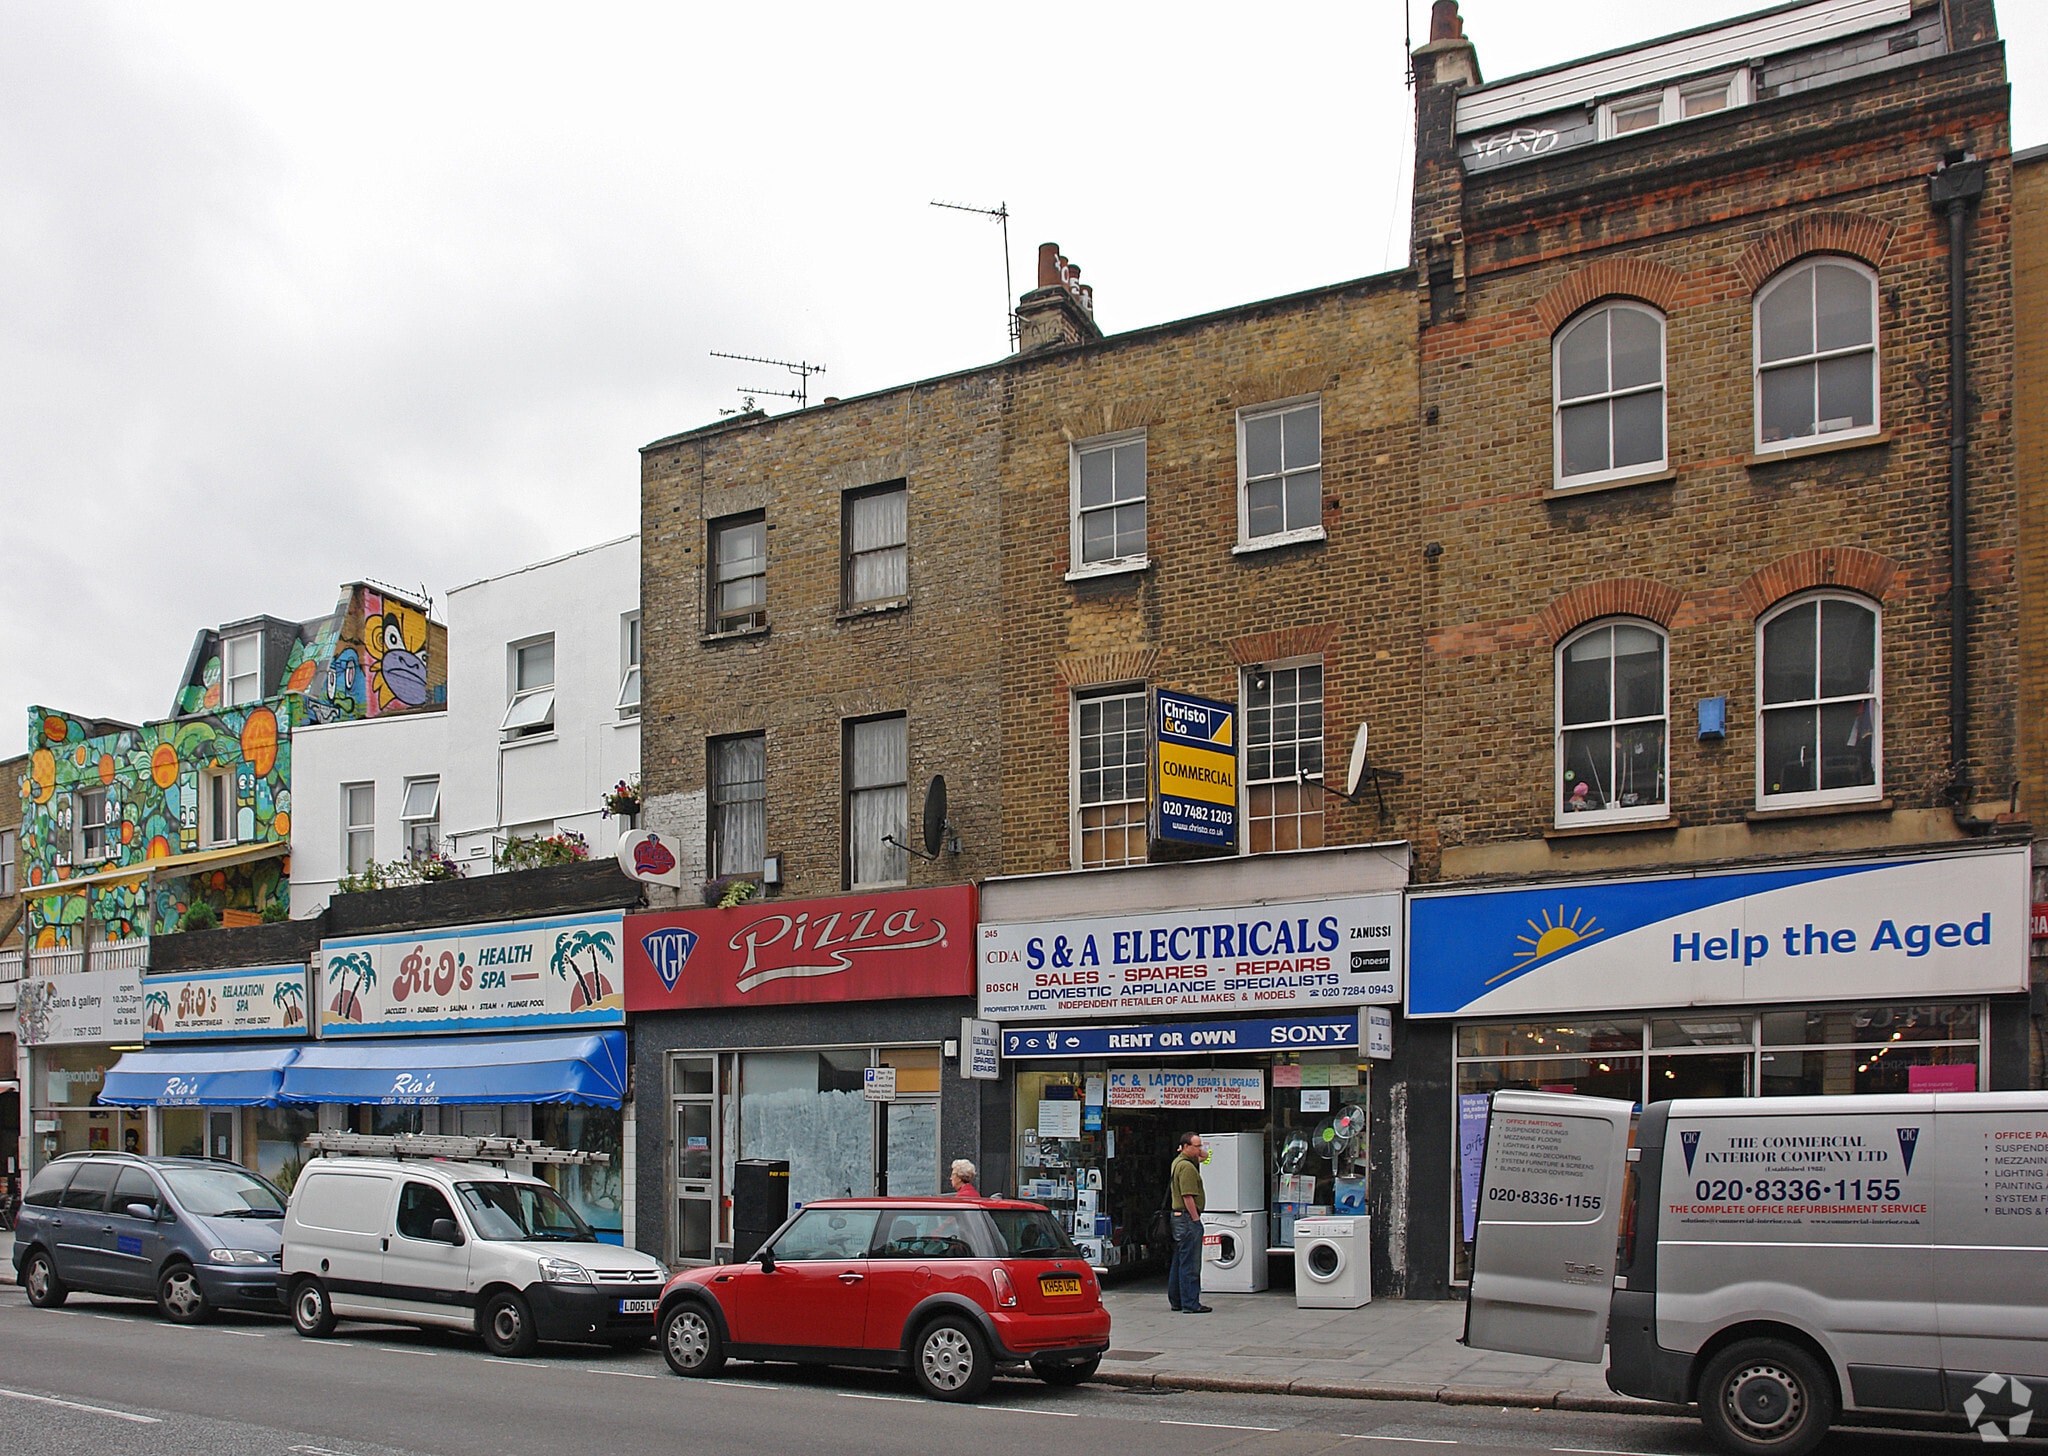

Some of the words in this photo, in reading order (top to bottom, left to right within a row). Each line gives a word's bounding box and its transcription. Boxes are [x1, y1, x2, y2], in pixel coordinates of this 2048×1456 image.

[1164, 702, 1206, 724] Christo
[1163, 760, 1233, 787] COMMERCIAL
[1163, 801, 1182, 816] 020
[1184, 804, 1208, 821] 7482
[1210, 809, 1232, 825] 1203
[1172, 821, 1224, 836] www.christo.co.uk
[984, 930, 998, 938] 245
[1350, 925, 1392, 939] ZANUSSI
[729, 908, 935, 982] Pizza
[1026, 937, 1045, 970] S
[1052, 935, 1073, 968] &
[1079, 934, 1100, 966] A
[1113, 916, 1339, 965] ELECTRICALS
[1673, 928, 1769, 967] Help
[1782, 923, 1857, 956] the
[1870, 912, 1991, 957] Aged
[478, 944, 533, 966] HEALTH
[650, 933, 690, 981] TGF
[1035, 971, 1100, 987] SALES
[1124, 965, 1208, 982] SPARES
[1236, 957, 1331, 976] REPAIRS
[479, 970, 506, 990] SPA
[1028, 986, 1112, 1000] DOMESTIC
[1120, 980, 1216, 995] APPLIANCE
[1224, 974, 1339, 990] SPECIALISTS
[119, 985, 134, 993] open
[222, 983, 264, 998] RELAXATION
[986, 983, 1019, 993] BOSCH
[1322, 988, 1339, 997] 020
[1342, 986, 1366, 996] 7284
[1368, 984, 1394, 995] 0943
[52, 997, 70, 1009] salon
[72, 996, 77, 1007] &
[79, 995, 101, 1009] gallery
[236, 999, 249, 1012] SPA
[529, 999, 544, 1007] POOL
[1058, 998, 1118, 1009] INDEPENDENT
[1121, 996, 1163, 1006] RETAILER
[1166, 995, 1178, 1005] OF
[1181, 994, 1198, 1004] ALL
[1201, 992, 1235, 1002] MAKES
[1242, 993, 1248, 1001] &
[1255, 990, 1296, 1001] MODELS
[984, 1004, 1019, 1013] PROPRIETOR
[191, 1018, 223, 1027] SPORTSWEAR
[1109, 1033, 1153, 1048] RENT
[1160, 1032, 1184, 1046] OR
[1190, 1030, 1237, 1044] OWN
[1271, 1024, 1351, 1043] SONY
[975, 1048, 994, 1056] SALES
[974, 1056, 996, 1065] SPARES
[973, 1064, 997, 1073] REPAIRS
[163, 1077, 198, 1096] Rio's
[390, 1073, 436, 1094] Rio's
[1112, 1073, 1126, 1086] PC
[1132, 1073, 1141, 1086] &
[1150, 1073, 1194, 1086] LAPTOP
[1198, 1078, 1220, 1087] REPAIRS
[1230, 1078, 1260, 1087] UPGRADES
[1683, 1133, 1698, 1144] CIC
[1728, 1137, 1758, 1149] THE
[1763, 1136, 1866, 1148] COMMERCIAL
[1900, 1130, 1916, 1142] CIC
[1526, 1159, 1558, 1167] FURNITURE
[1543, 1153, 1581, 1161] DECORATING
[1705, 1151, 1776, 1164] INTERIOR
[1782, 1150, 1854, 1163] COMPANY
[1857, 1150, 1888, 1162] LTD
[1995, 1169, 2044, 1177] LIGHTING
[1669, 1205, 1688, 1213] THE
[1691, 1205, 1745, 1213] COMPLETE
[1747, 1205, 1784, 1213] OFFICE
[1787, 1204, 1878, 1213] REFURBISHMENT
[1881, 1204, 1927, 1213] SERVICE
[1995, 1207, 2032, 1215] BLINDS
[1204, 1236, 1221, 1244] SALE
[647, 1301, 658, 1311] LY
